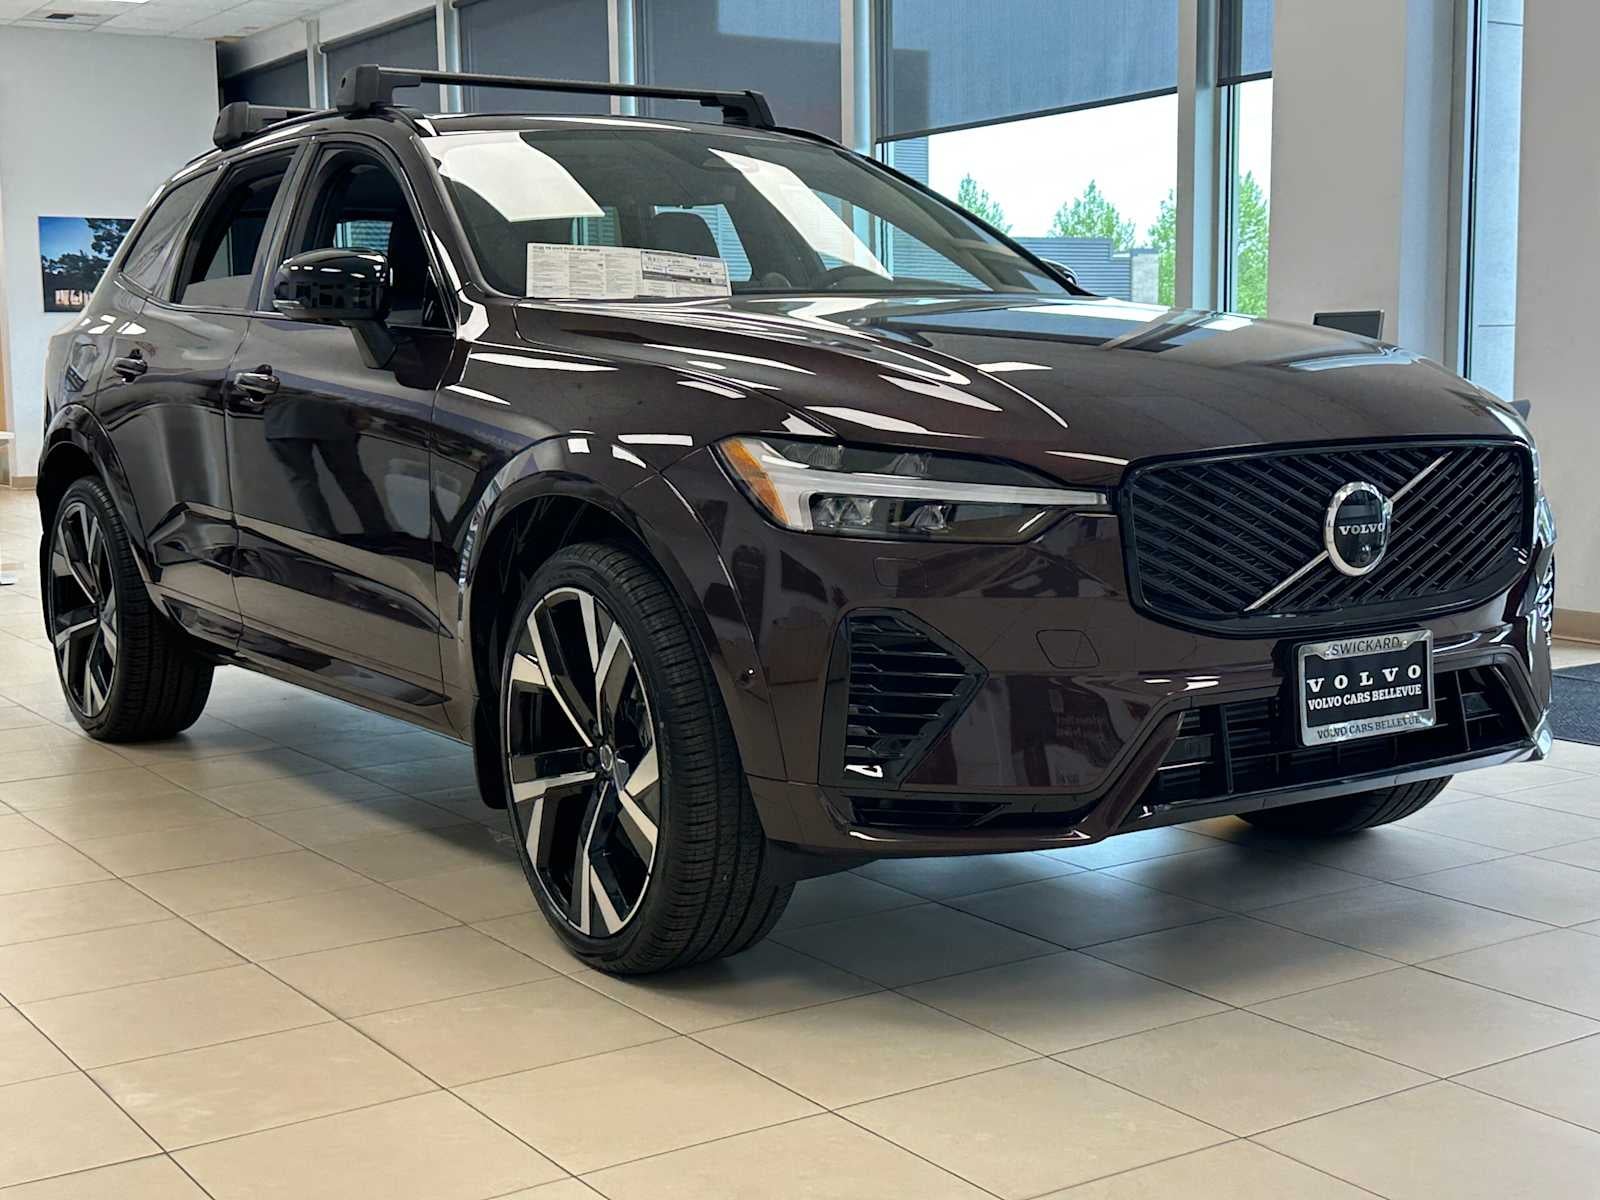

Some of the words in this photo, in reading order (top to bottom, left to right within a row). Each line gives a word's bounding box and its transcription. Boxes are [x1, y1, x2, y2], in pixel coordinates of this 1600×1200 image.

[1339, 522, 1385, 535] VOLVO
[1331, 636, 1400, 656] SWICKARD
[1306, 664, 1421, 693] VOLVO
[1308, 695, 1342, 710] VOLVO
[1343, 691, 1371, 705] CARS
[1372, 684, 1422, 702] BELLEVUE
[1317, 726, 1348, 740] VOLVO
[1349, 721, 1374, 735] CARS
[1375, 715, 1421, 730] BELLEVUE
